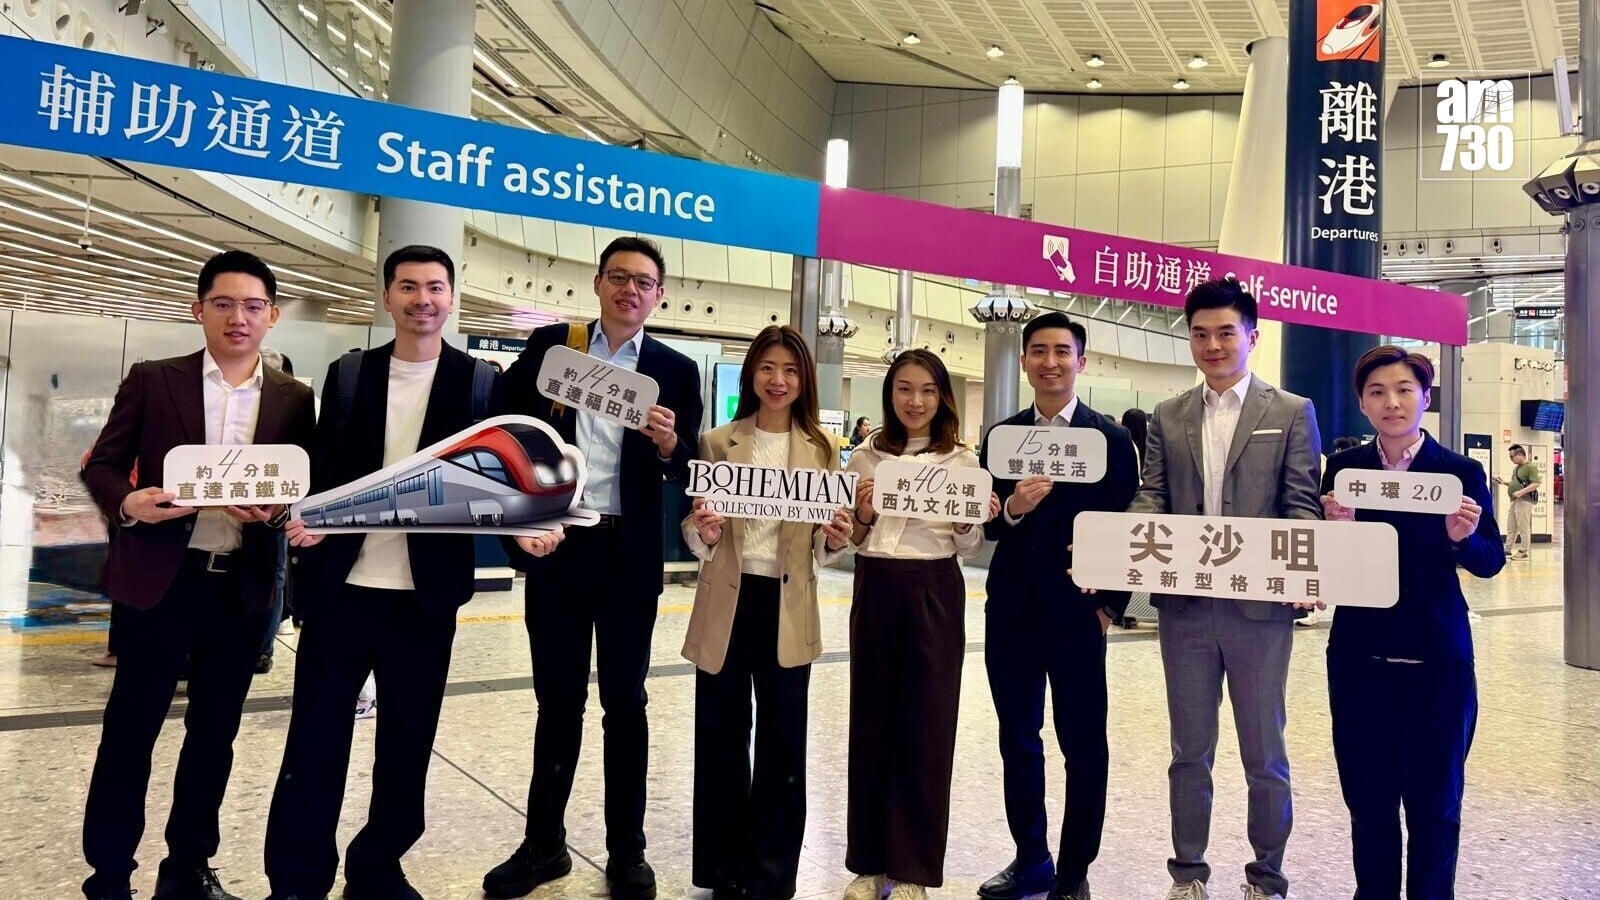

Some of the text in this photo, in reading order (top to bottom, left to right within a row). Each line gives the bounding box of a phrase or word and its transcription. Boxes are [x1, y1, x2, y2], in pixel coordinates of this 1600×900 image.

[38, 63, 347, 170] 輔助通道
[1318, 80, 1378, 216] 離港
[376, 131, 716, 223] Staff assistance
[1311, 226, 1379, 242] Departures
[1094, 245, 1212, 296] 自助通道
[544, 377, 643, 426] 直達福田站
[687, 462, 857, 506] BOHEMIAN
[1008, 458, 1088, 478] 雙城生活
[176, 480, 300, 501] 直達高鐵站
[881, 492, 982, 518] 西九文化區
[1411, 484, 1443, 502] 2.0
[704, 500, 783, 518] COLLECTION
[787, 505, 803, 519] BY
[1129, 520, 1319, 573] 尖沙咀
[1126, 567, 1321, 598] 全新型格項目
